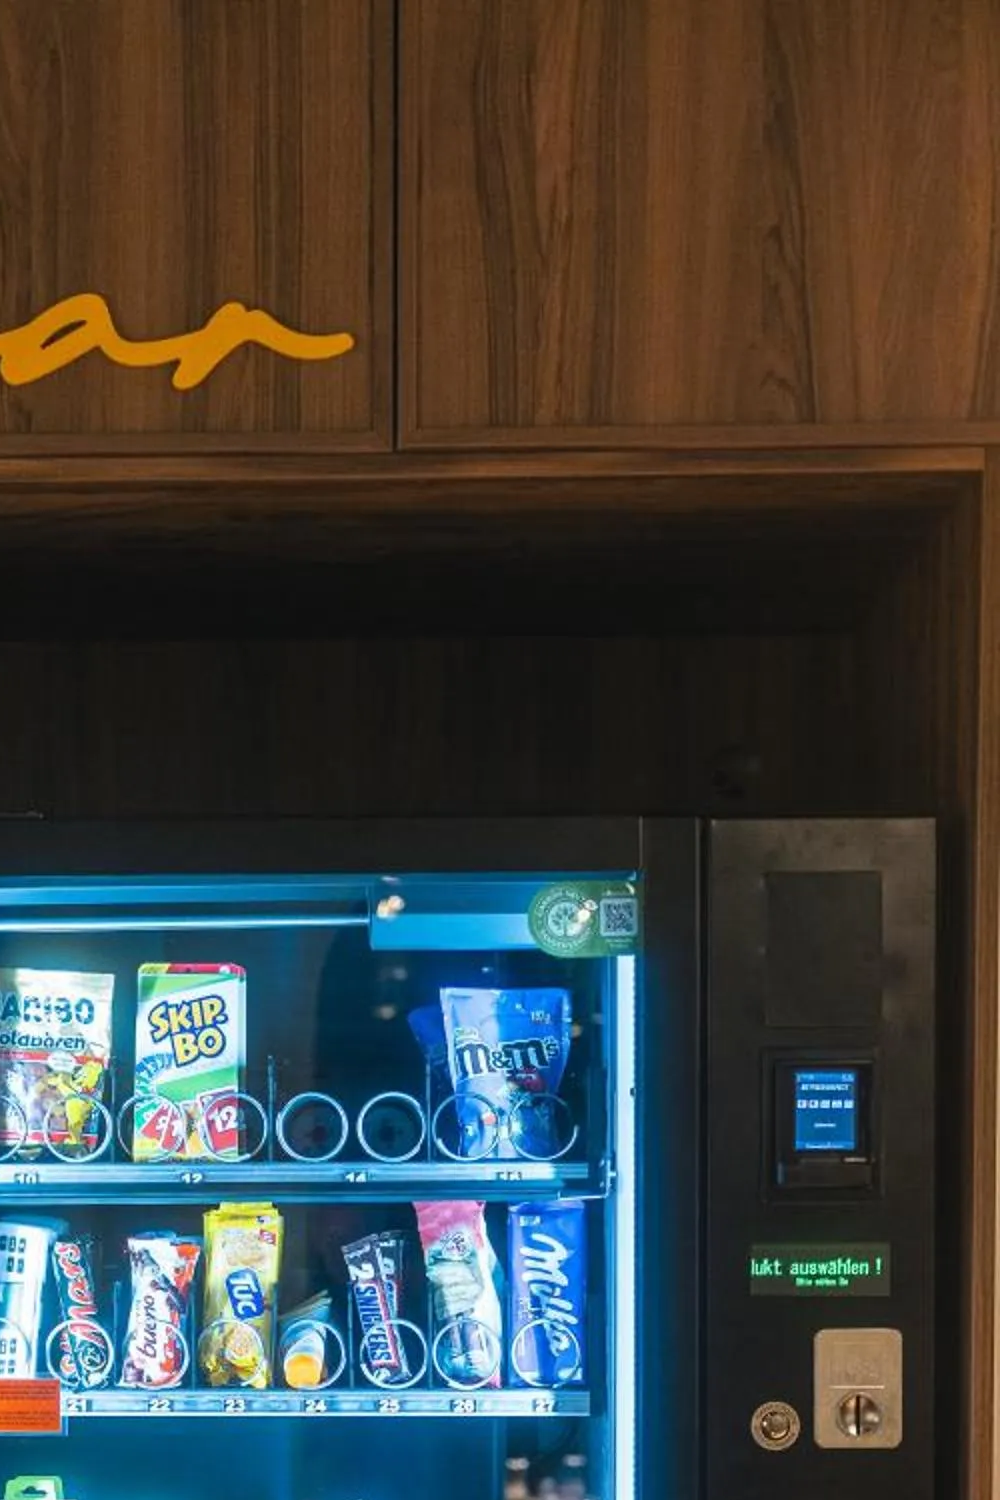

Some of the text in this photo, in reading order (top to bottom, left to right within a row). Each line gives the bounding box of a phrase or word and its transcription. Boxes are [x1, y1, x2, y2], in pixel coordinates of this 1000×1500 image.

[171, 1027, 226, 1067] BO
[790, 1257, 869, 1275] auswählen
[229, 1270, 258, 1316] TUC
[136, 1294, 157, 1359] bueno
[355, 1284, 393, 1361] SNICKERS
[149, 1400, 171, 1412] 22
[225, 1400, 245, 1412] 23
[305, 1400, 327, 1412] 24
[379, 1400, 401, 1412] 25
[454, 1400, 475, 1412] 26
